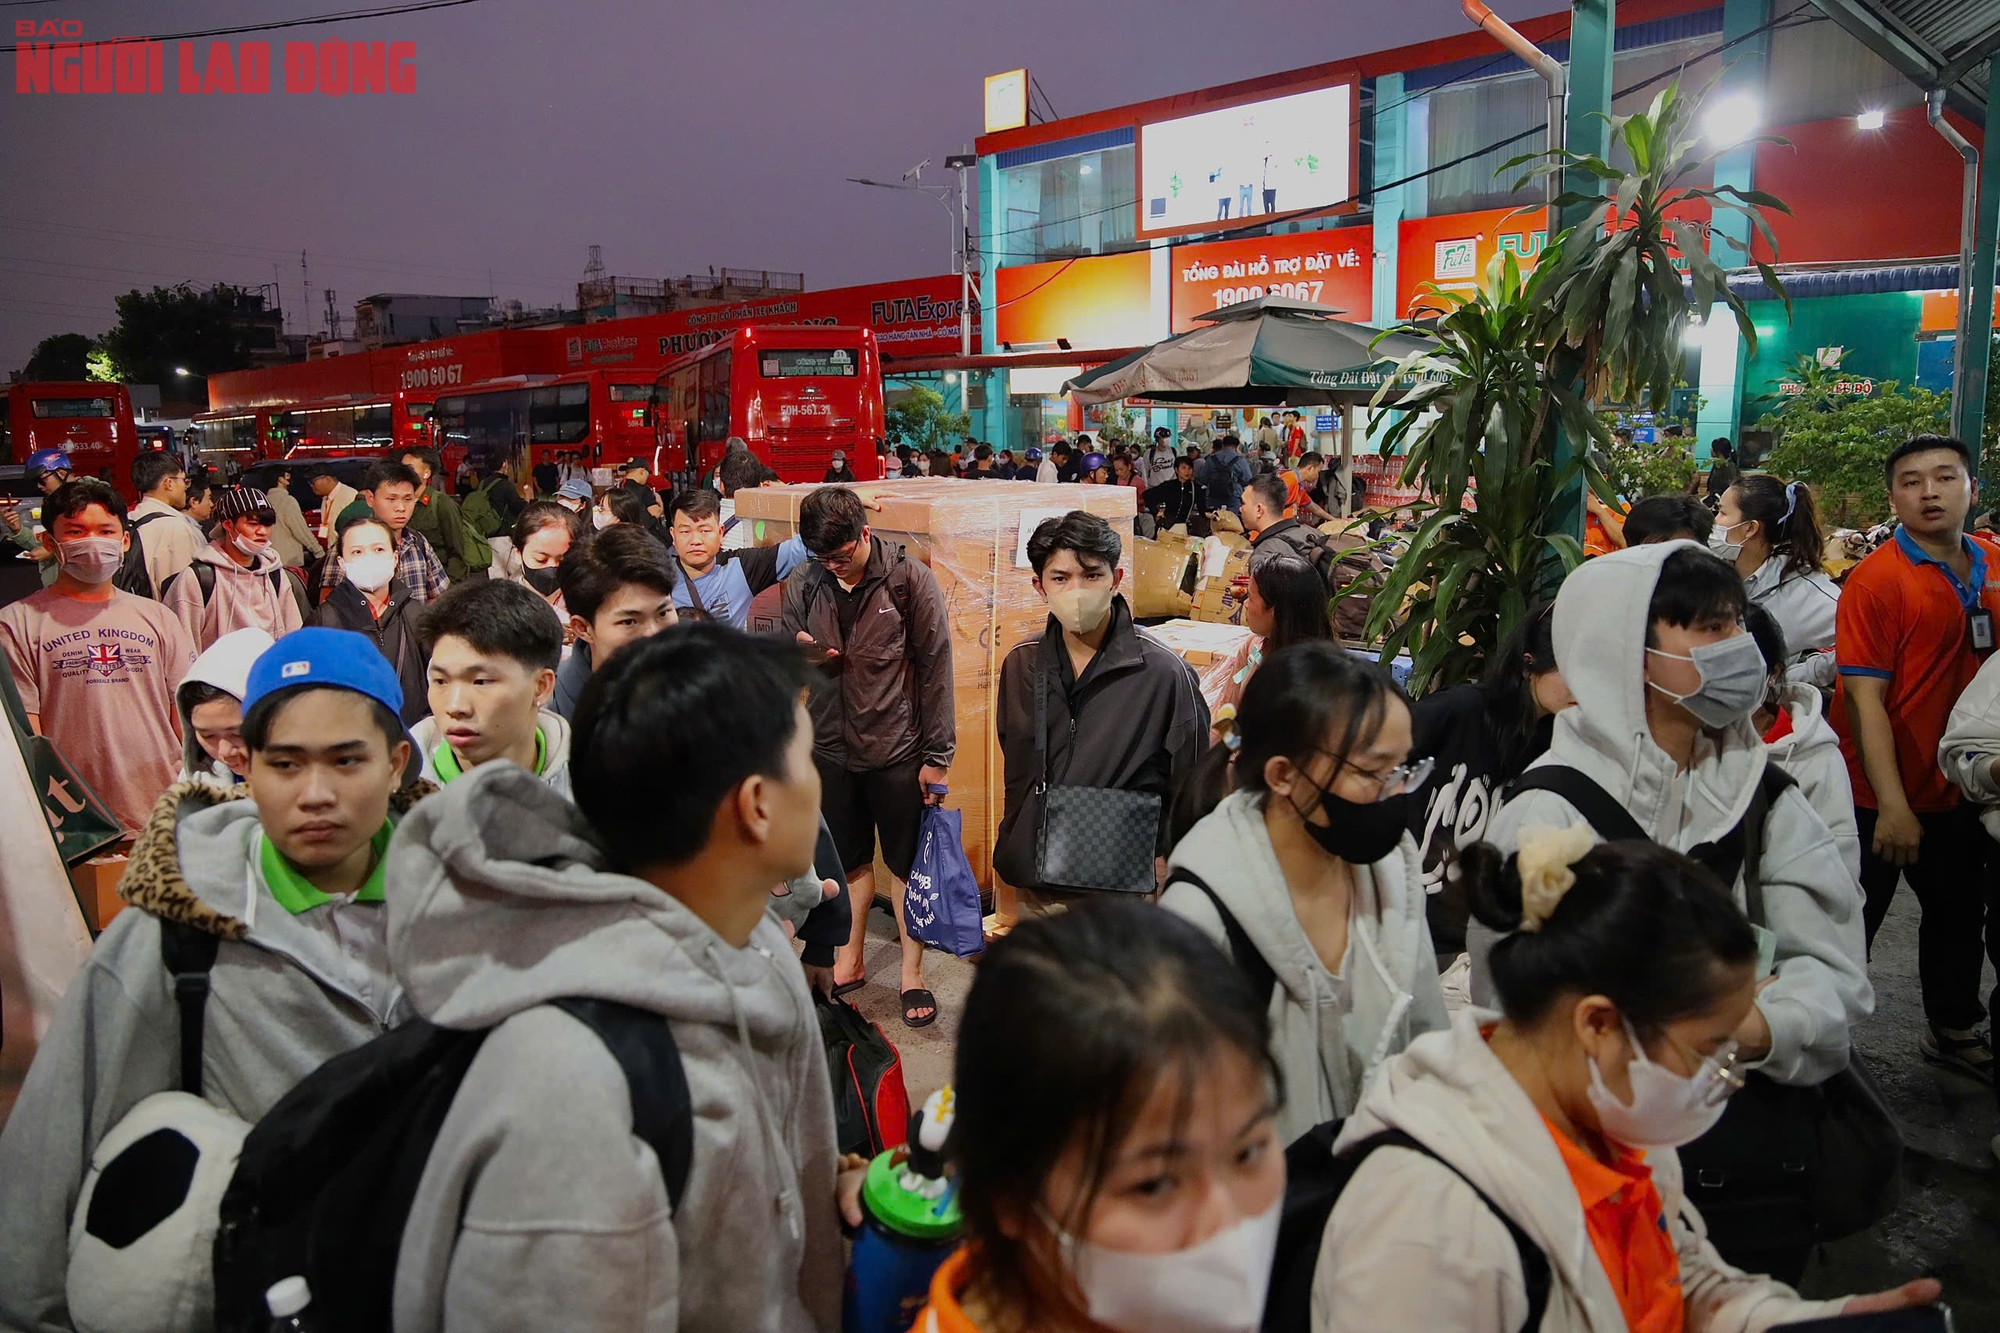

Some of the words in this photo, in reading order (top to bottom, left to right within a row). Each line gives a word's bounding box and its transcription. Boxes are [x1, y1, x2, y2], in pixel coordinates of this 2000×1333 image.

[1498, 230, 1548, 258] FUT
[1182, 259, 1219, 282] TỔNG
[1222, 260, 1245, 279] ĐÀI
[1248, 254, 1269, 276] HỖ
[1273, 256, 1301, 276] TRỢ
[1304, 252, 1333, 274] ĐẶT
[686, 312, 707, 326] CÔNG
[708, 312, 718, 323] TY
[719, 306, 731, 322] CỔ
[731, 304, 754, 320] PHẦN
[755, 306, 767, 317] XE
[768, 301, 797, 315] KHÁCH
[401, 367, 429, 390] 1900
[1338, 371, 1359, 385] Đài
[1361, 371, 1380, 387] Đặt
[57, 442, 100, 451] 50533.40
[757, 623, 770, 633] MD
[42, 630, 91, 653] UNITED
[98, 628, 154, 648] KINGDOM
[62, 650, 83, 658] DENIM
[62, 669, 90, 678] QUALITY
